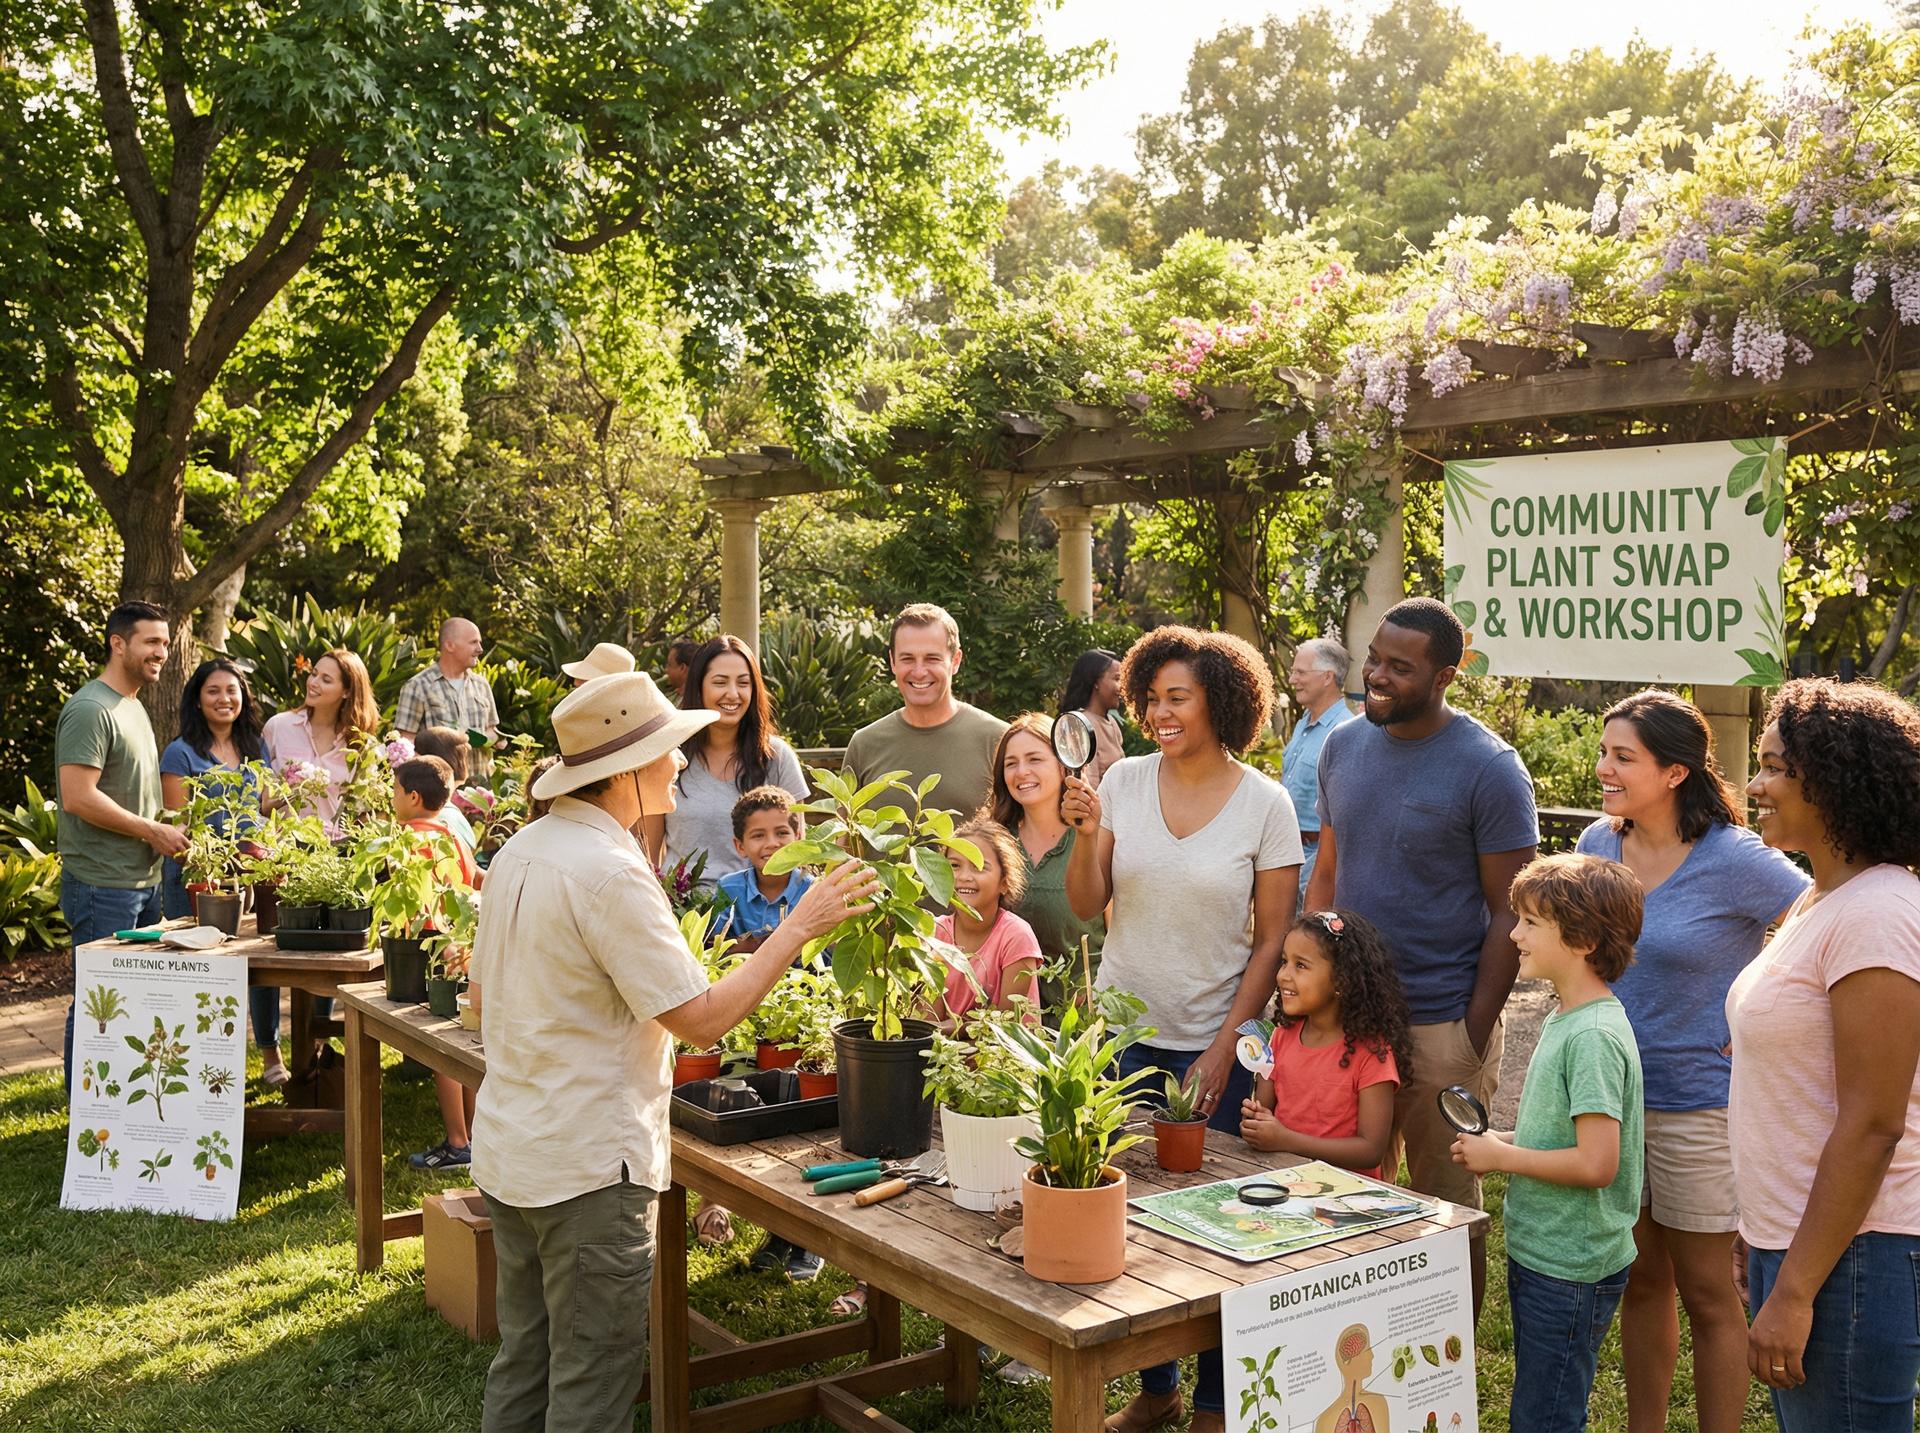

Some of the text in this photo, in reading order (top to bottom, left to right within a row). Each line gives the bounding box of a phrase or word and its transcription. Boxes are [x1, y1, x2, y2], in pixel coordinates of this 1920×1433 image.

[1490, 485, 1721, 538] COMMUNITY
[1487, 542, 1730, 587] PLANT SWAP
[1483, 597, 1743, 642] & WORKSHOP
